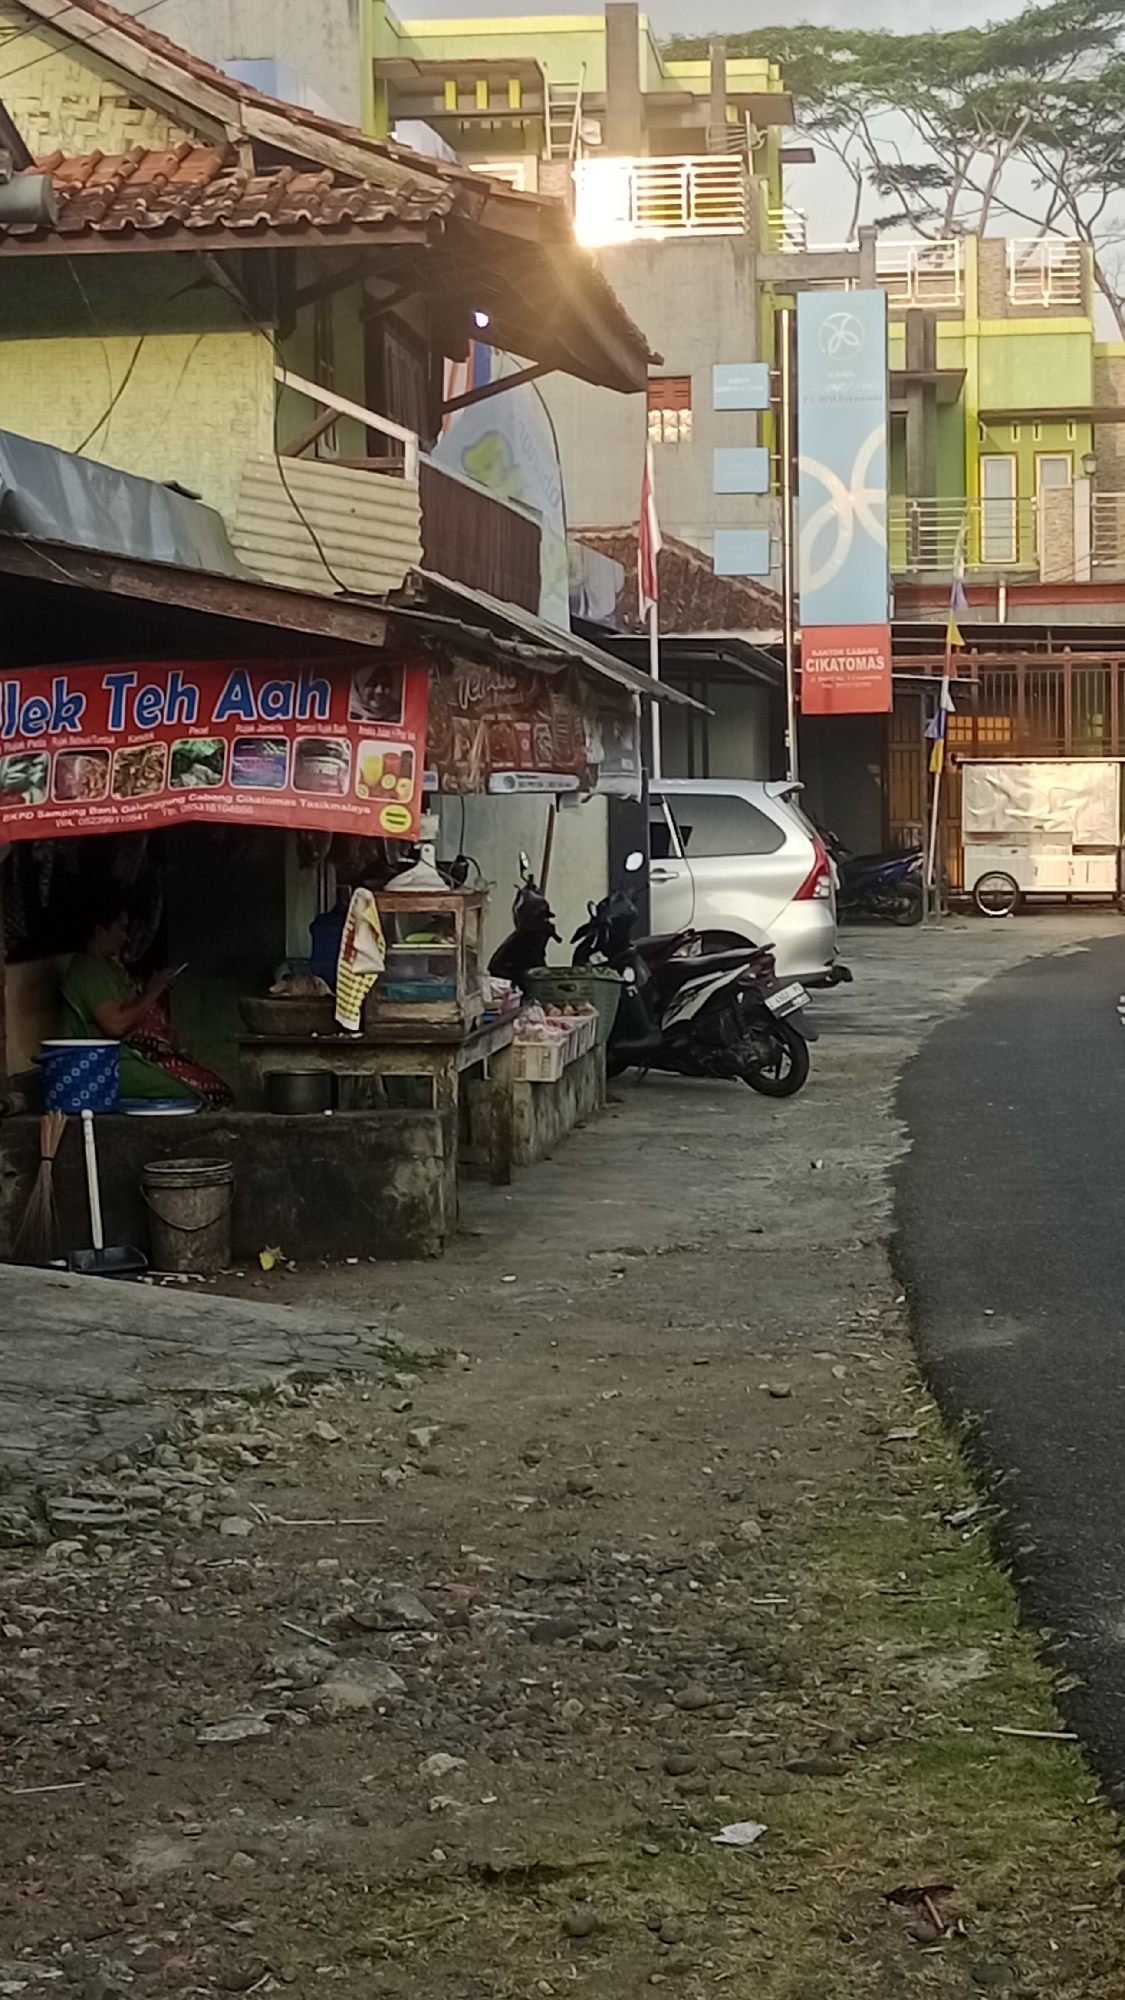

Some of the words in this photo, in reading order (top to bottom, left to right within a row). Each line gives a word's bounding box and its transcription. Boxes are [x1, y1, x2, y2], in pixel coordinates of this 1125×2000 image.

[805, 655, 885, 673] CIKATOMAS
[0, 676, 87, 739] lek
[102, 669, 199, 732] Teh
[37, 806, 86, 819] Samping
[88, 805, 119, 815] Bank
[188, 792, 234, 804] Cabang
[236, 793, 297, 807] Cikatomas
[299, 797, 371, 815] Tasikmalaya
